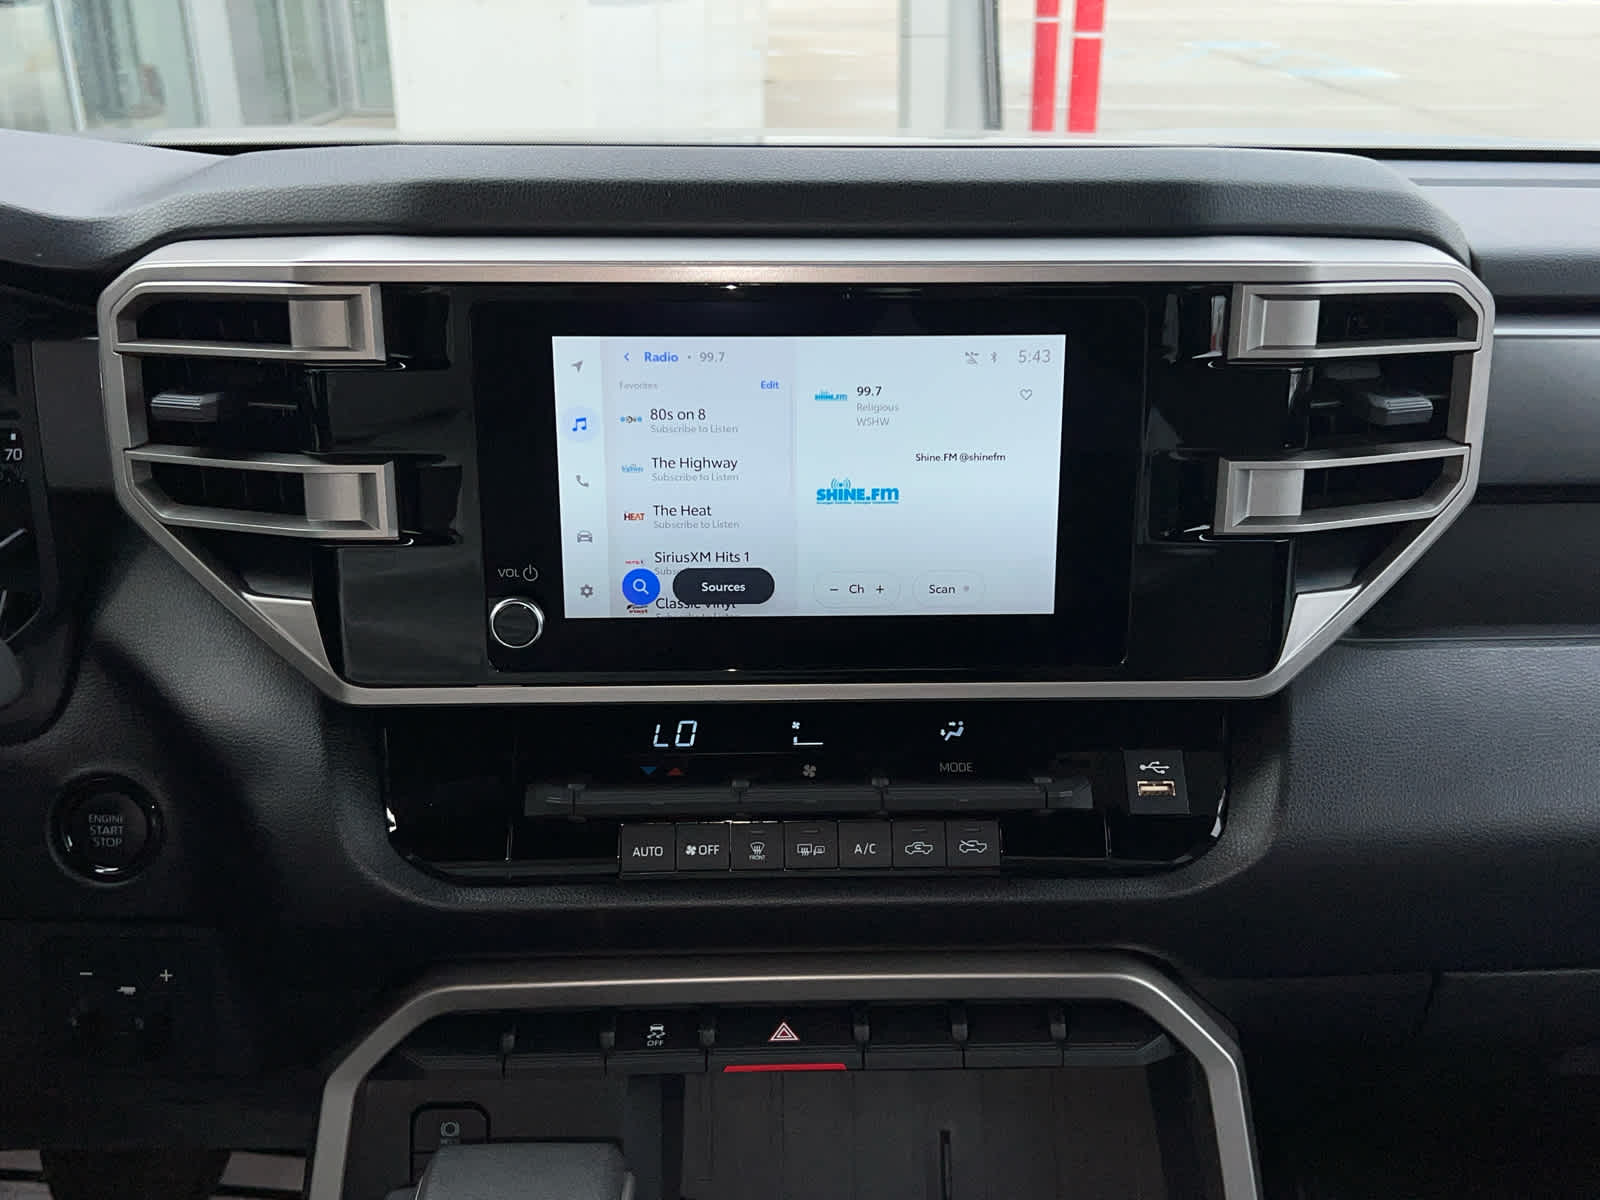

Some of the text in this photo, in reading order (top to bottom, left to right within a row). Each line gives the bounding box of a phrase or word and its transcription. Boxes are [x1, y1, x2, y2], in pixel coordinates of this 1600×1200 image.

[644, 351, 725, 363] Radio 99.7
[1018, 350, 1051, 364] 5:43
[619, 381, 658, 391] Favorites
[760, 380, 780, 390] Edit
[857, 386, 882, 397] 99.7
[650, 408, 674, 420] 80s
[677, 411, 694, 420] on
[698, 408, 706, 420] 8
[856, 403, 900, 414] Religious
[856, 416, 890, 426] WSHW
[650, 425, 739, 433] Subscribe to Listen
[4, 448, 23, 461] 70
[915, 452, 1006, 462] Shine.FM @shinefm
[652, 457, 676, 469] The
[679, 457, 738, 472] Highway
[652, 473, 739, 481] Subscribe to Listen
[653, 505, 712, 516] The Heat
[623, 513, 645, 521] HEAT
[654, 521, 740, 529] Subscribe to Listen
[654, 552, 711, 563] SiriusXM
[715, 552, 741, 563] Hits
[744, 552, 750, 562] 1
[498, 568, 520, 578] VOL
[701, 582, 746, 592] Sources
[849, 584, 865, 594] Ch
[929, 584, 956, 594] Scan
[939, 762, 974, 773] MODE
[88, 814, 124, 824] ENGINE
[89, 825, 124, 836] START
[94, 837, 123, 848] STOP
[632, 846, 664, 857] AUTO
[698, 844, 720, 855] OFF
[854, 843, 876, 855] A/C
[647, 1039, 664, 1047] OFF
